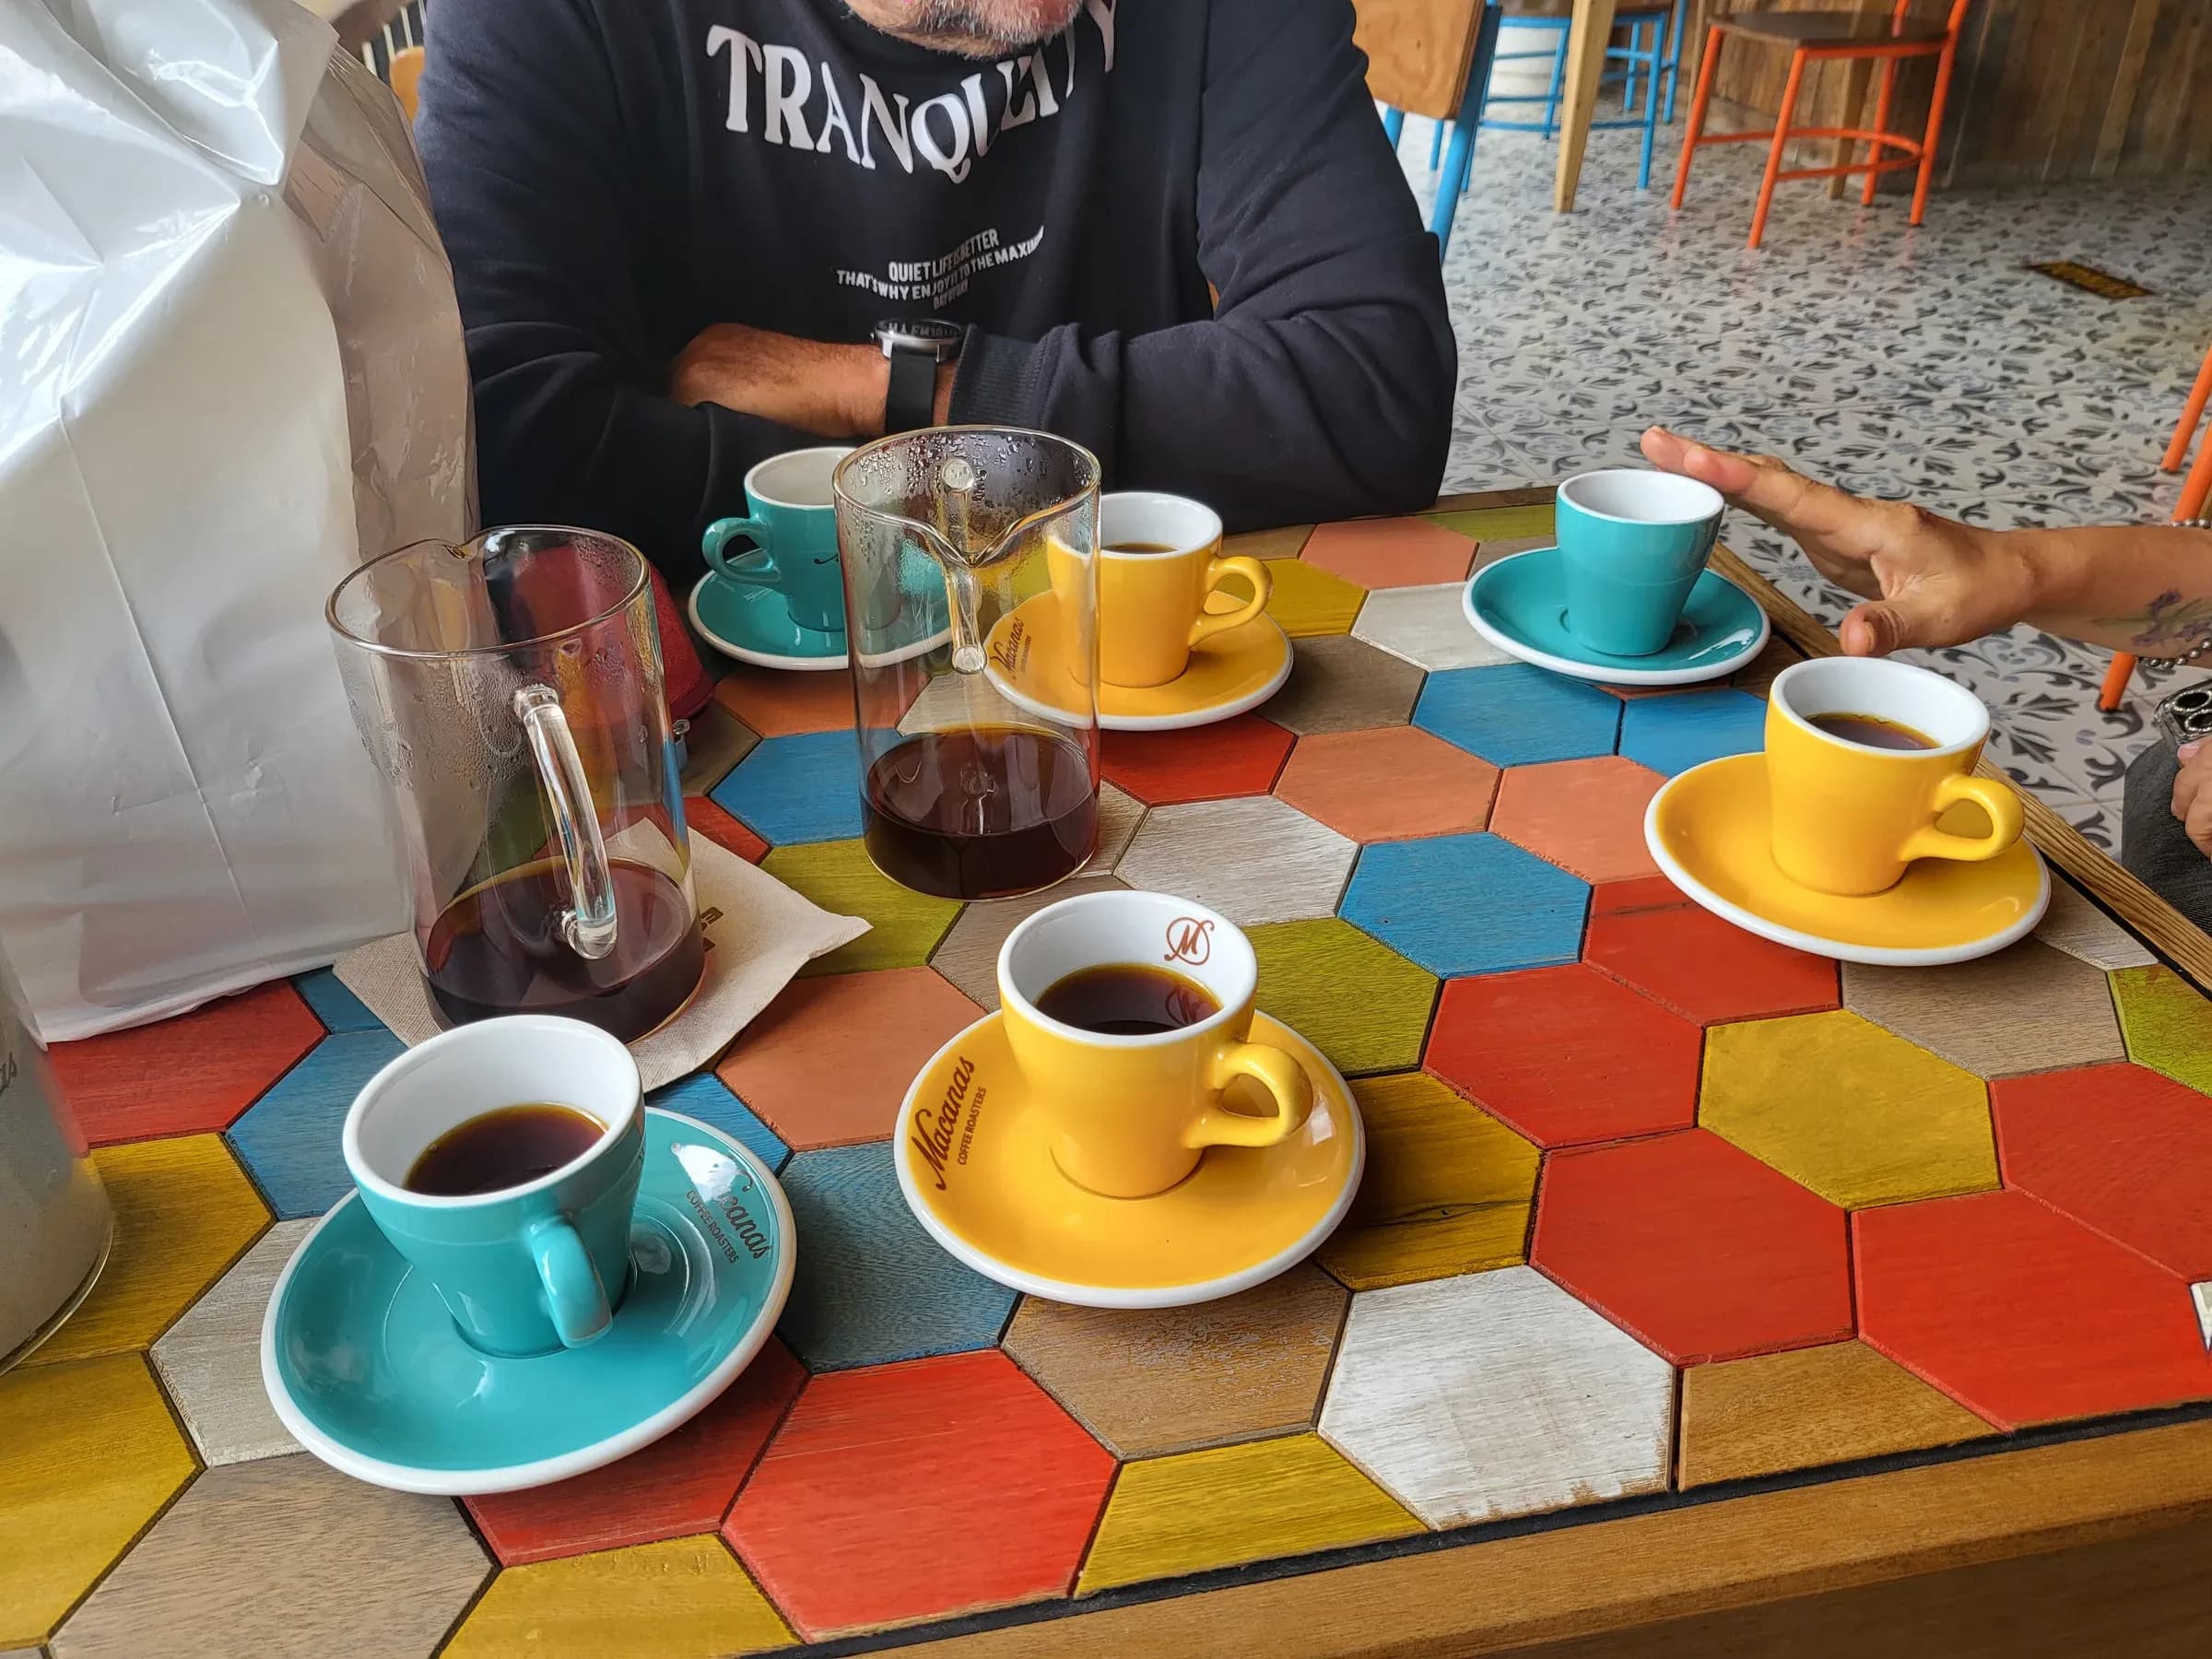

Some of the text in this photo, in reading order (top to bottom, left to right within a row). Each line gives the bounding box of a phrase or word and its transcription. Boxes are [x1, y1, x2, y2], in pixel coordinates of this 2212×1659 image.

[836, 269, 878, 294] THAT'S
[877, 282, 911, 301] WHY
[959, 263, 971, 280] TO
[971, 252, 995, 274] THE
[888, 260, 932, 283] QUIET
[932, 253, 953, 278] LIFE
[959, 228, 999, 262] BETTER
[911, 1055, 975, 1191] Macanas
[957, 1086, 988, 1166] COFFEE ROASTERS
[686, 1190, 740, 1265] COFFEE ROASTERS
